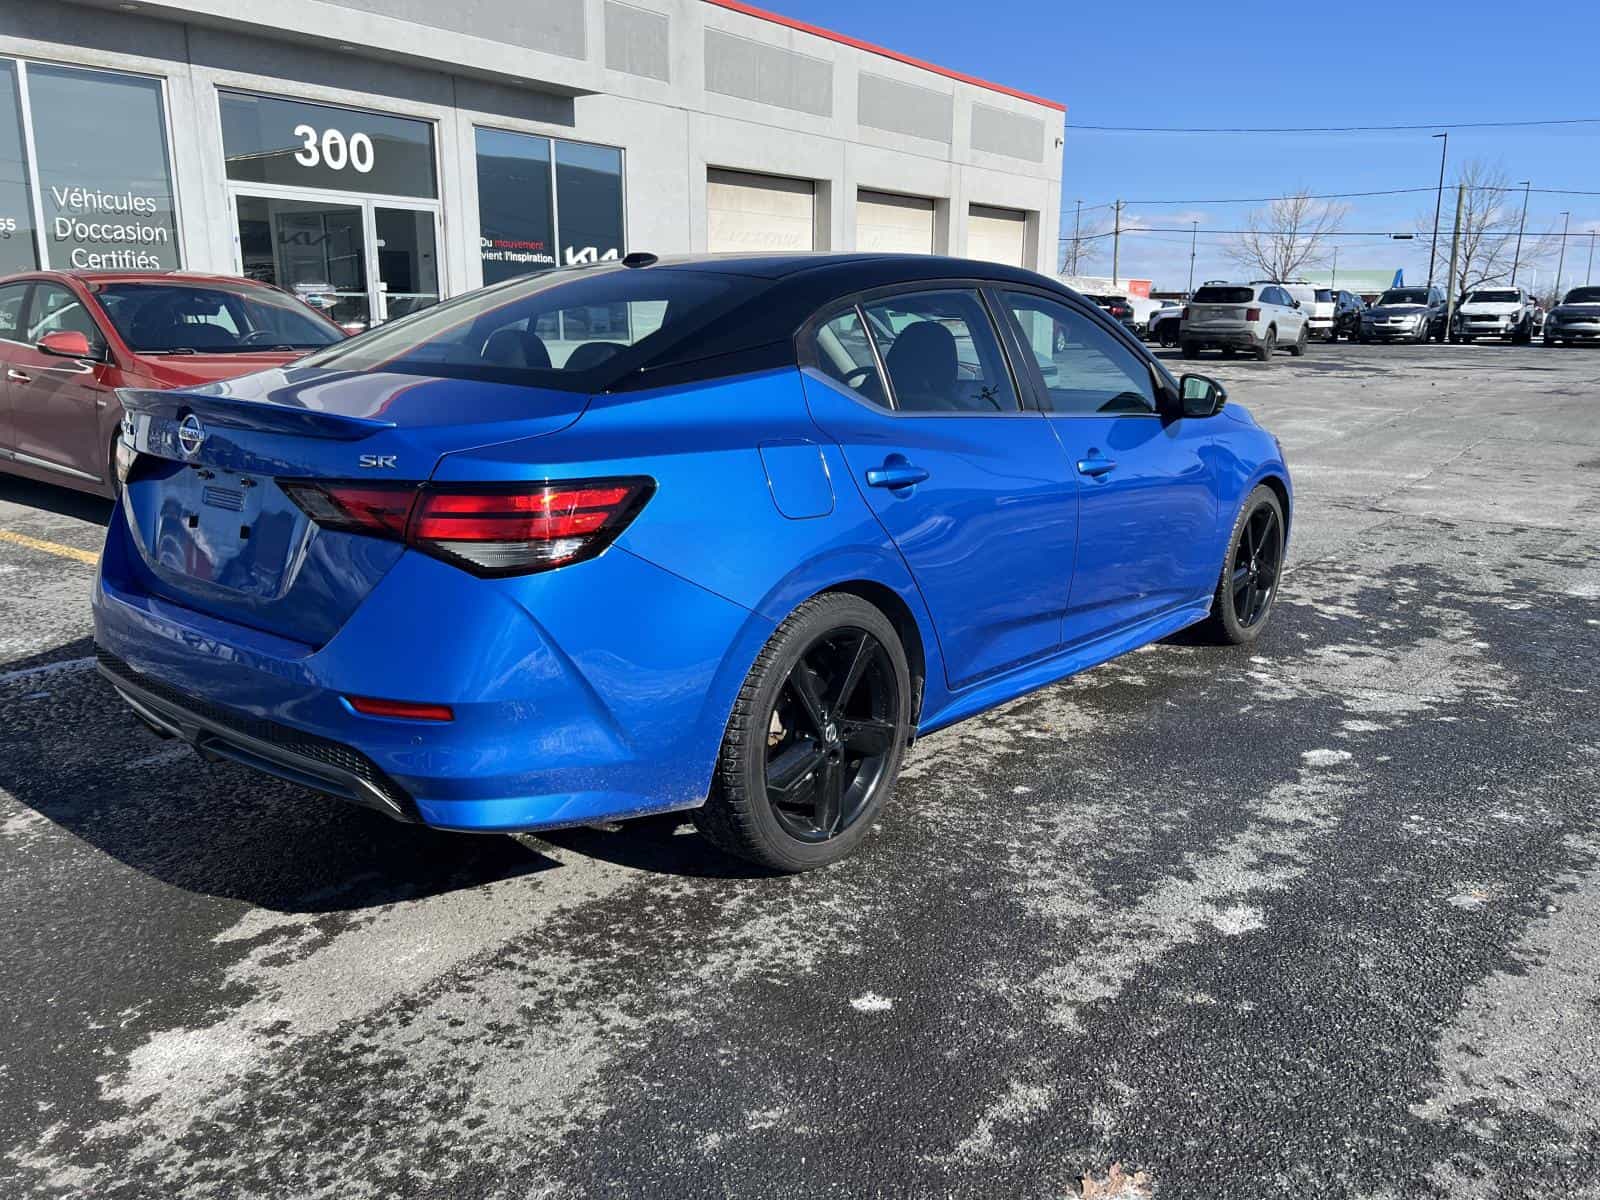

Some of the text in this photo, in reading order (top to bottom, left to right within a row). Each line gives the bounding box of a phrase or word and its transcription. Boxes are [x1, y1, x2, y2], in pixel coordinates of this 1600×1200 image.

[294, 125, 374, 173] 300
[52, 186, 157, 212] Véhicules
[55, 217, 168, 242] D'occasion
[480, 237, 545, 250] Du mouvement
[71, 248, 160, 269] Certifiés
[565, 245, 619, 265] KIA
[359, 454, 397, 469] SR
